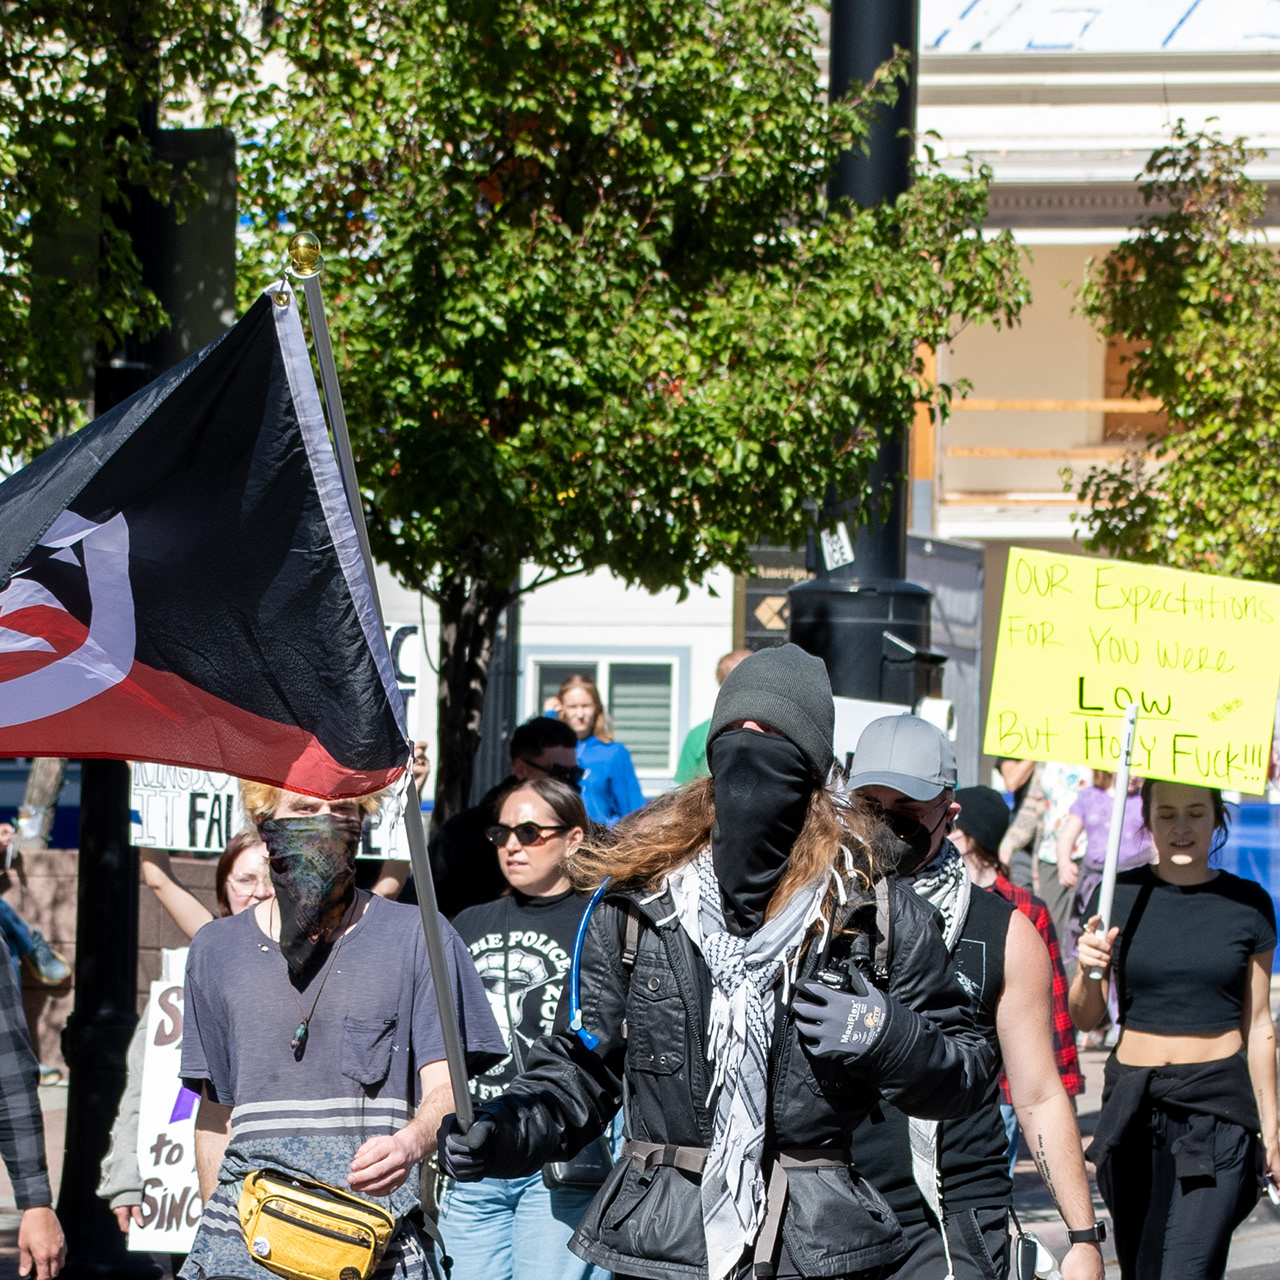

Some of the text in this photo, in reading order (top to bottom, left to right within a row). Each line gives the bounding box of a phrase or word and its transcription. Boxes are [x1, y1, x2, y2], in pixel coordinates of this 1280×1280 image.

[1015, 558, 1274, 624] OUR Expectations
[1008, 615, 1063, 649] FOR
[1089, 626, 1139, 664] YOU
[133, 788, 182, 846] IT
[508, 931, 571, 973] POLICE
[150, 1133, 184, 1167] to
